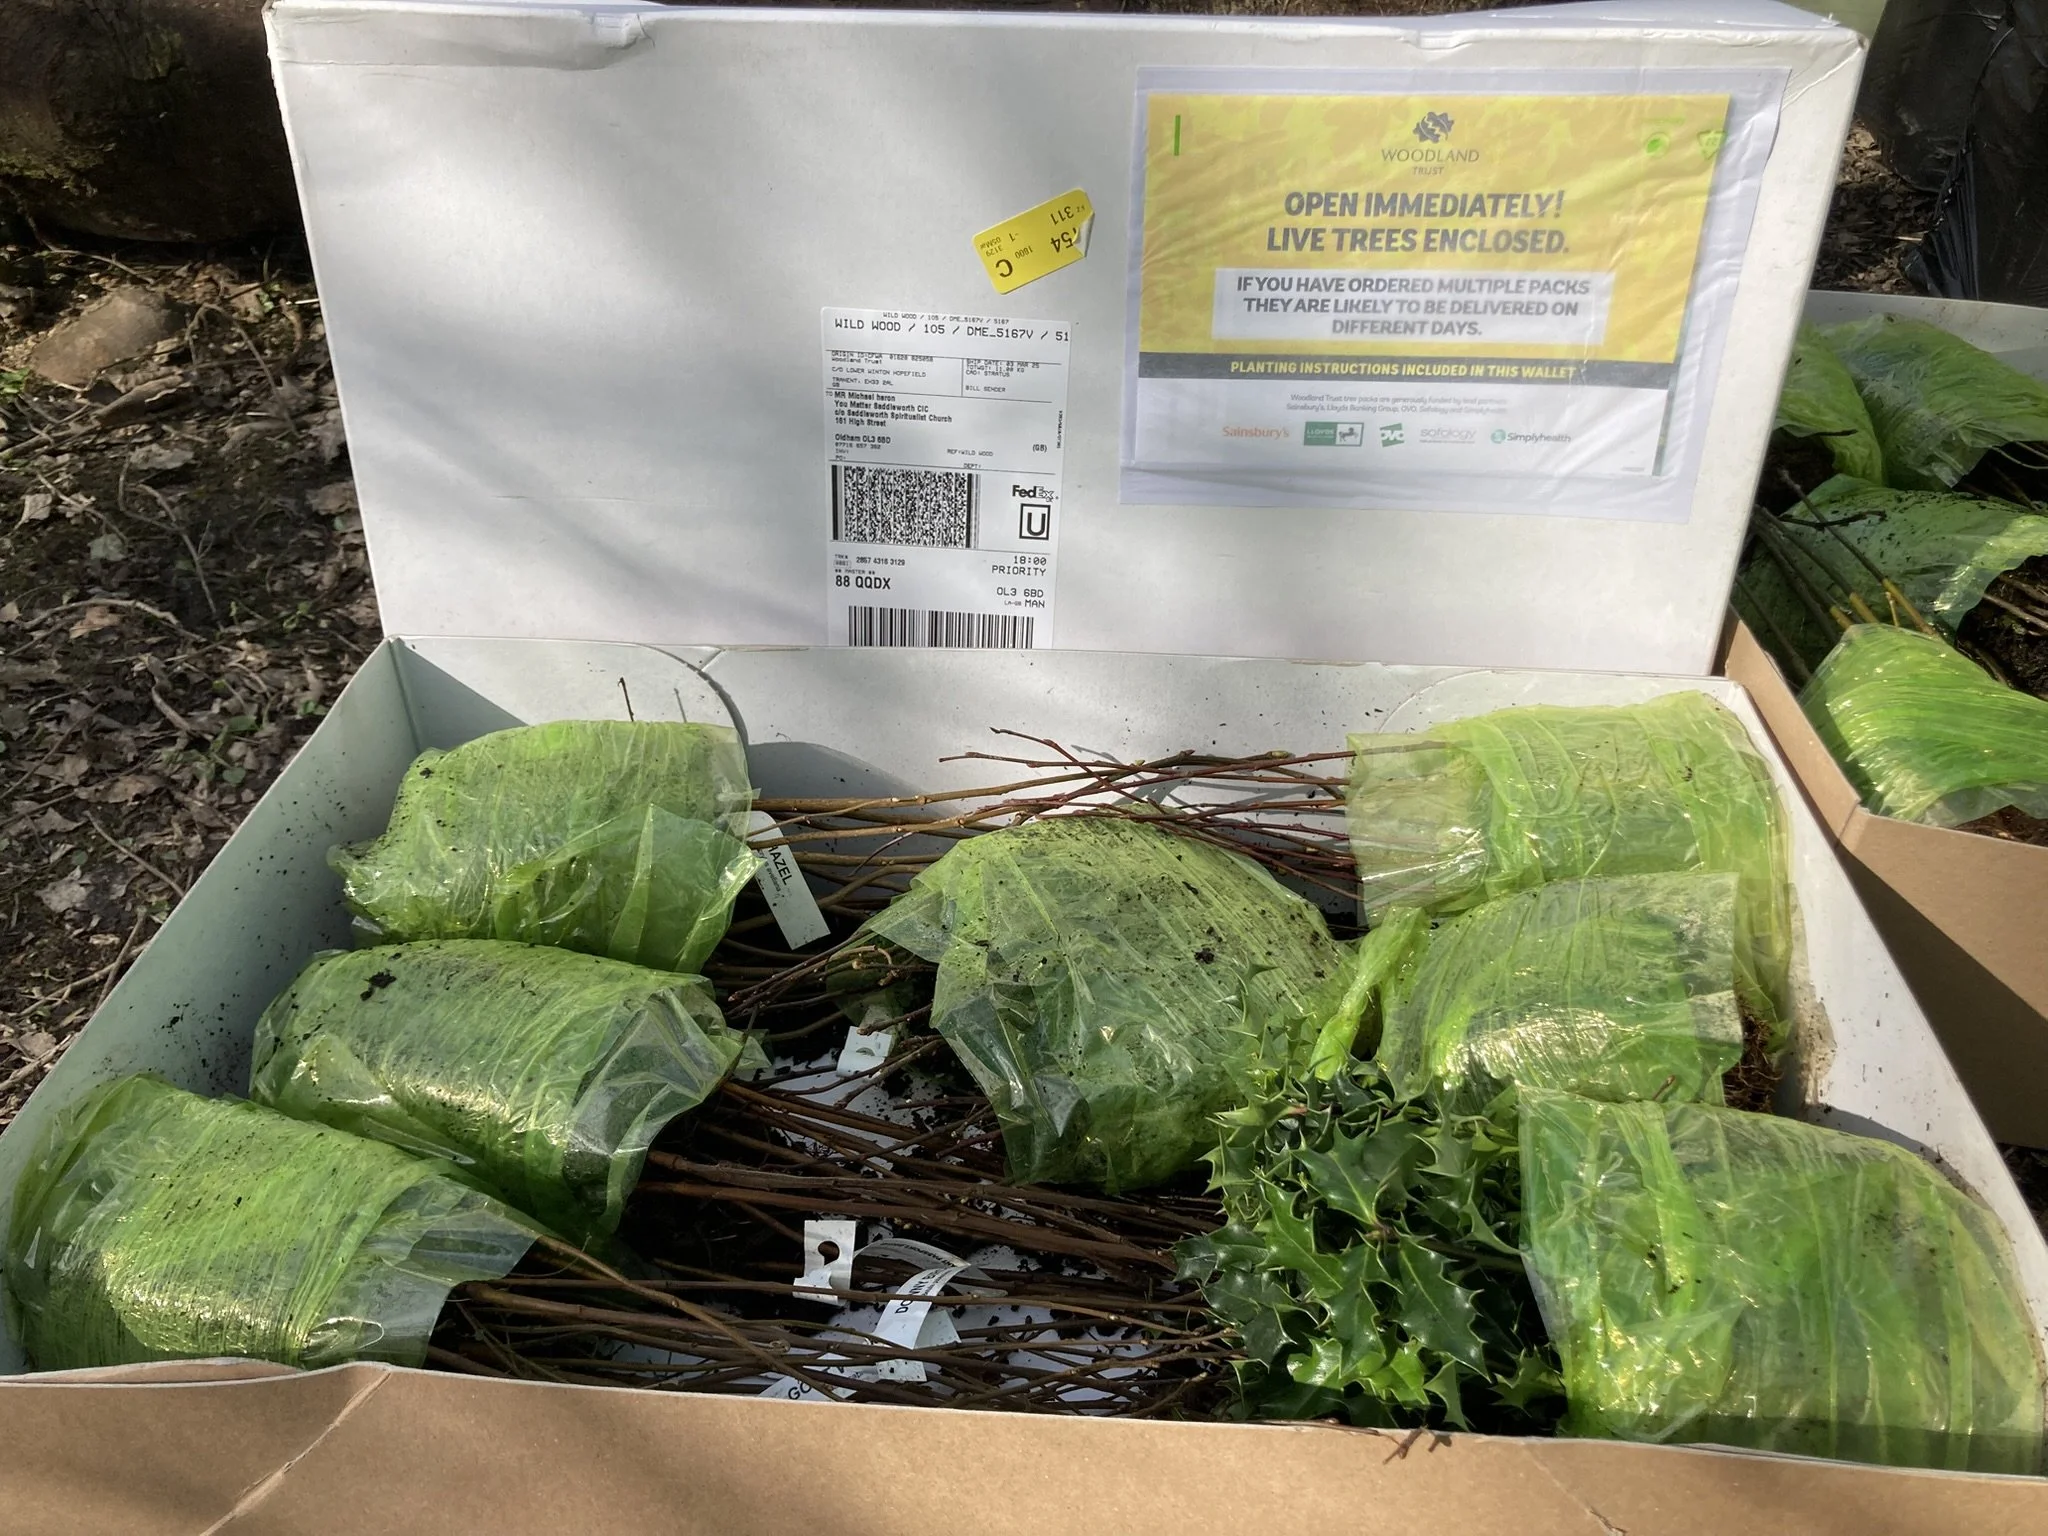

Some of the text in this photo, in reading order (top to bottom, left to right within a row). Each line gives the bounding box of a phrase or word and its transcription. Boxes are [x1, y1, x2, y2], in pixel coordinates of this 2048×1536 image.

[1381, 149, 1479, 164] WOODLAND
[1412, 167, 1444, 176] TRUST
[1285, 190, 1565, 218] OPEN IMMEDIATELY!
[1050, 206, 1075, 226] 311
[1050, 227, 1077, 253] 54
[1267, 227, 1570, 254] LIVE TREES ENCLOSED.
[995, 259, 1014, 278] C
[1237, 277, 1590, 296] IF YOU HAVE ORDERED MULTIPLE PACKS
[1243, 298, 1578, 316] THEY ARE LIKELY TO BE DELIVERED ON
[834, 318, 1069, 342] WILD WOOD / 105 / DME_5167V / 51
[1332, 319, 1483, 336] DIFFERENT DAYS.
[893, 370, 926, 378] HOPEFIELD
[1230, 361, 1576, 379] PLANTING INSTRUCTIONS INCLUDED IN THIS WALLET
[834, 391, 846, 399] MR
[848, 391, 875, 400] Michael
[1290, 394, 1325, 402] Woodland
[834, 400, 929, 413] You Matter Saddleworth CIC
[1327, 404, 1348, 413] Lloyds
[847, 409, 888, 419] Saddleworth
[890, 412, 926, 421] Spiritualist
[929, 414, 952, 423] Church
[848, 418, 865, 427] High
[867, 419, 886, 428] Street
[835, 433, 861, 442] Oldham
[862, 435, 876, 443] OL3
[1222, 426, 1290, 440] Sainsbury's
[1420, 428, 1477, 441] sofology
[1507, 432, 1572, 444] Simplyhealth
[1032, 444, 1048, 453] (GB)
[1012, 485, 1054, 502] FedEx
[1027, 512, 1046, 537] U
[1014, 555, 1047, 565] 18:00
[992, 565, 1047, 576] PRIORITY
[835, 575, 891, 590] 88 QQDX
[997, 587, 1044, 598] OL3 6BD
[1025, 599, 1045, 608] MAN
